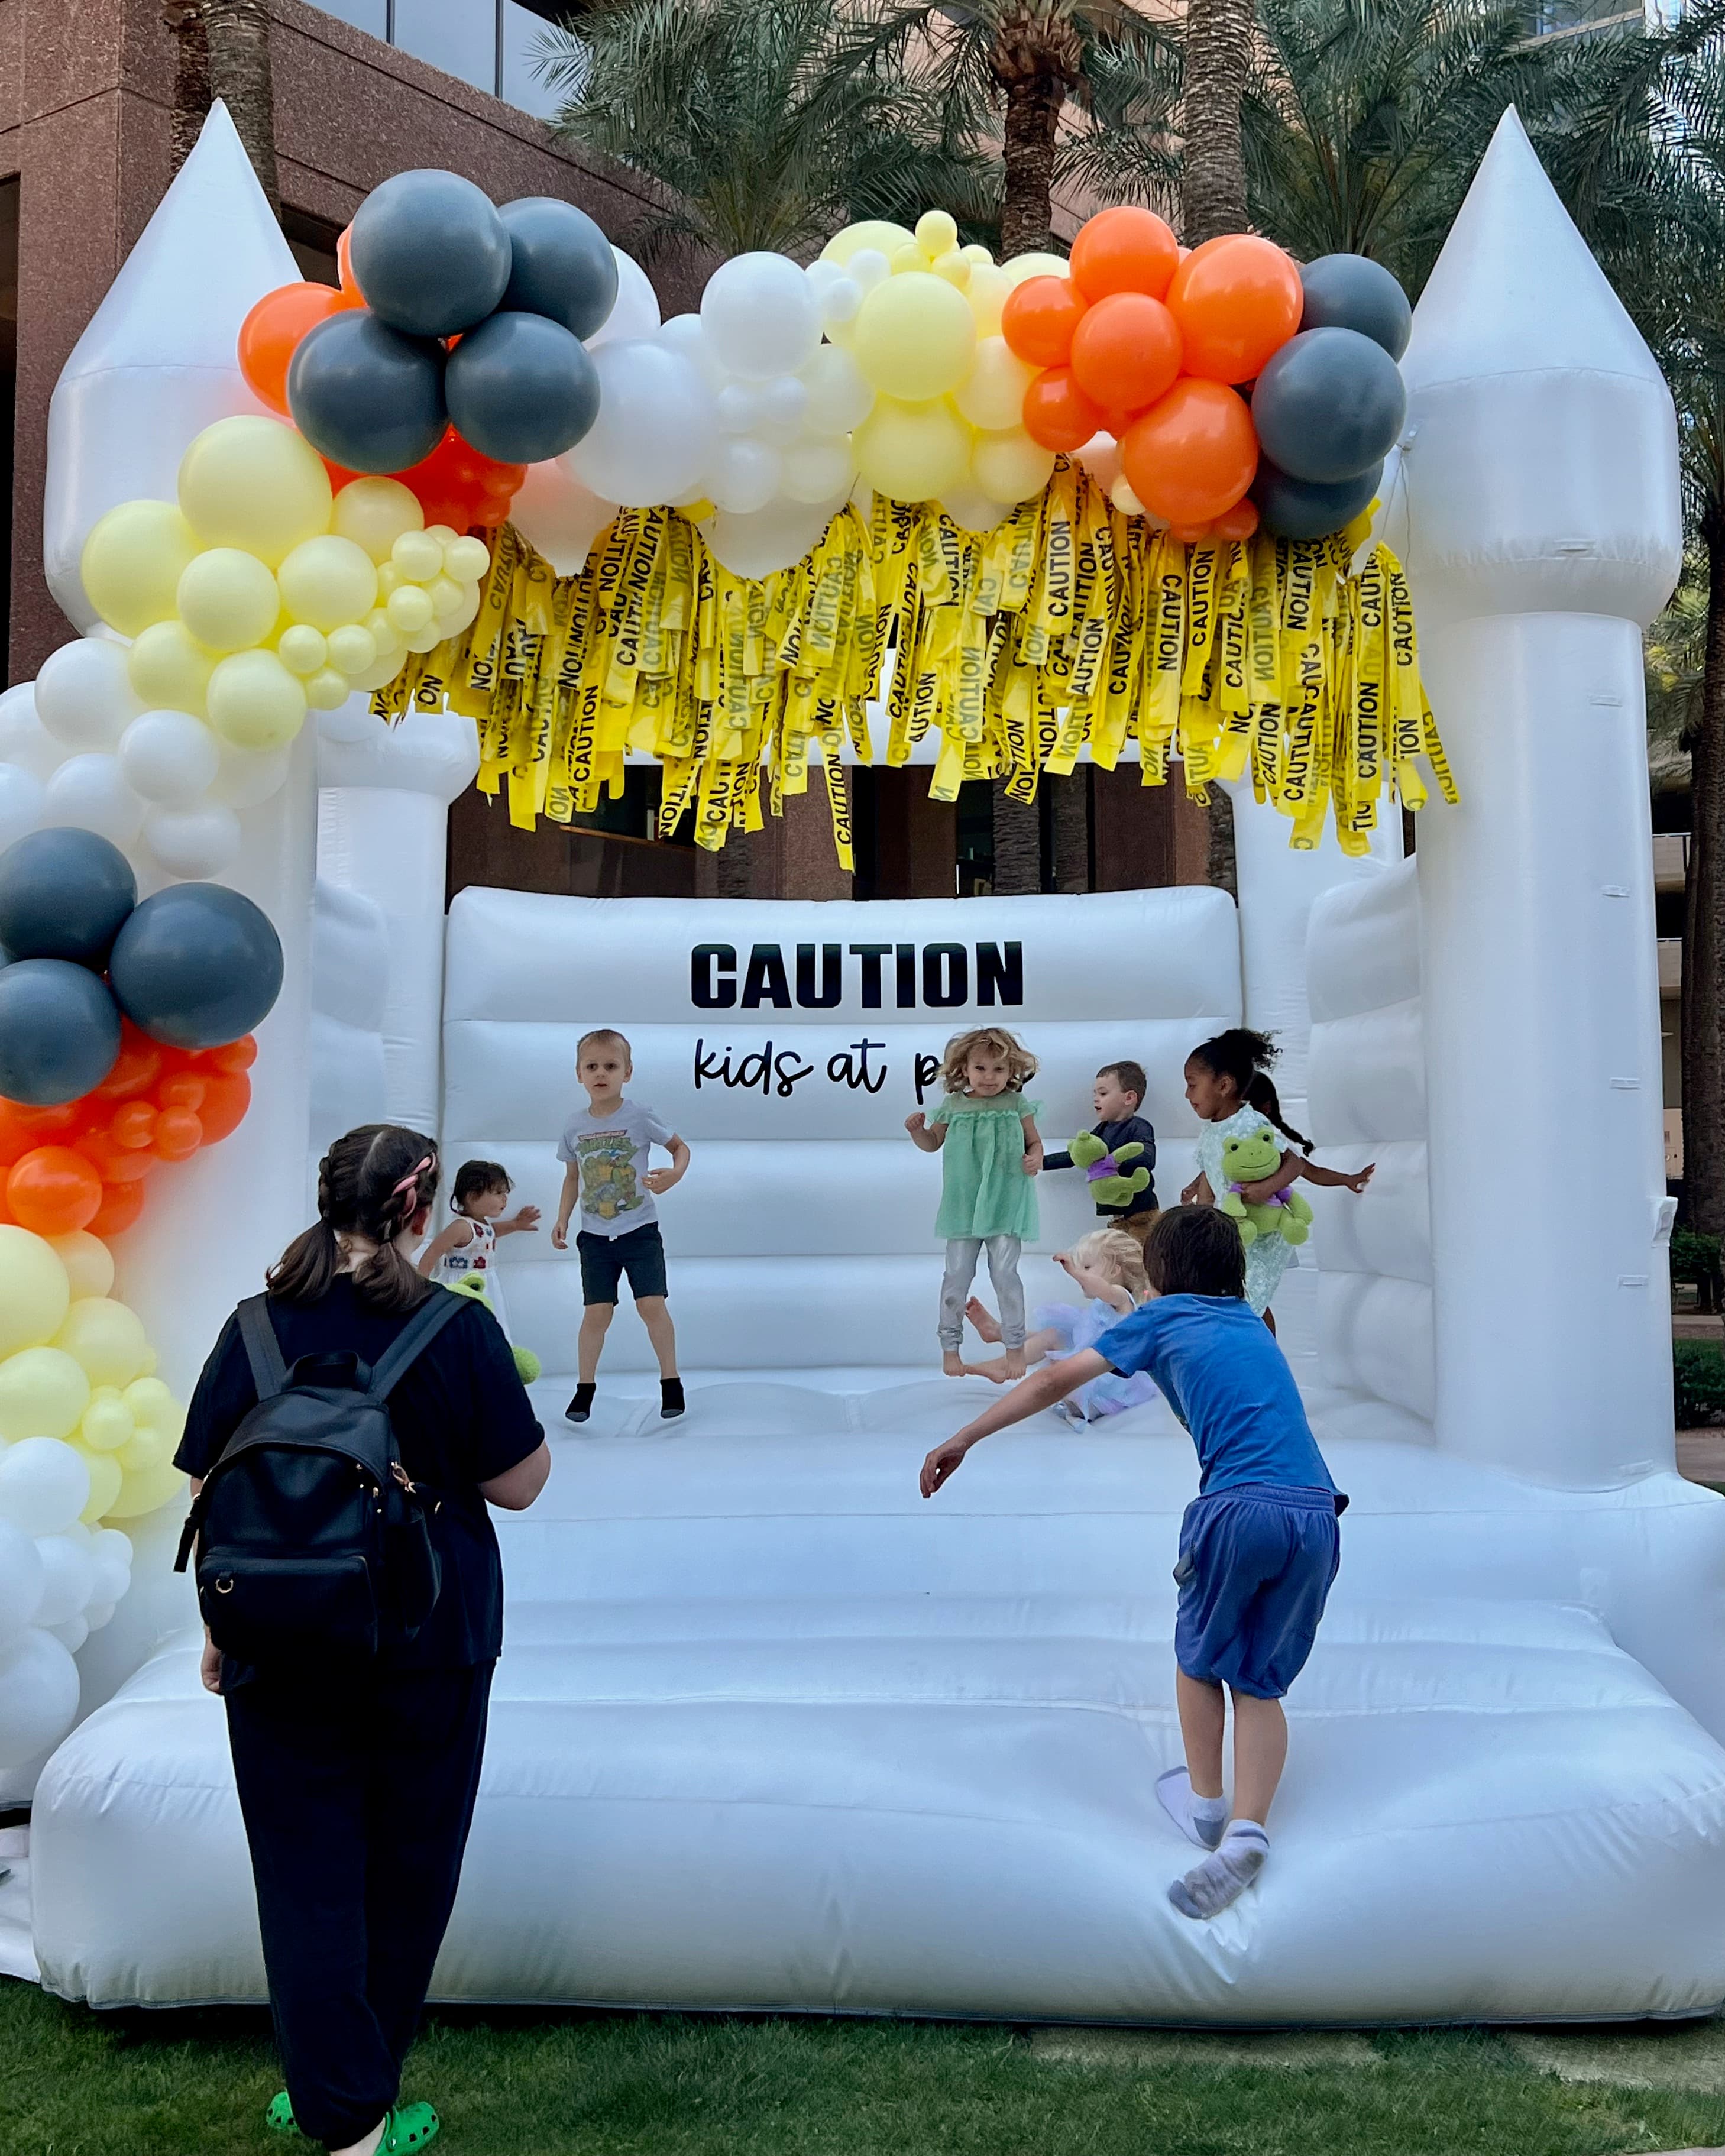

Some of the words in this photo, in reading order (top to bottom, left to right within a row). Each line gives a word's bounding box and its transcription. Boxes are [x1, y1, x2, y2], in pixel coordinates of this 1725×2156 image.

[628, 507, 664, 591] AUTION
[1048, 521, 1070, 617] CAUTION
[1287, 540, 1312, 630] CAUTION
[1158, 575, 1182, 670] CAUTION
[1192, 550, 1215, 646] CAUTION
[1391, 572, 1412, 665] CAUTION
[574, 685, 598, 782] CAUTION
[1258, 704, 1281, 785] CAUTION
[1358, 682, 1379, 778] CAUTION
[827, 754, 852, 844] CAUTION
[691, 941, 1024, 1008] CAUTION
[695, 1038, 814, 1097] kids
[827, 1038, 888, 1093] at
